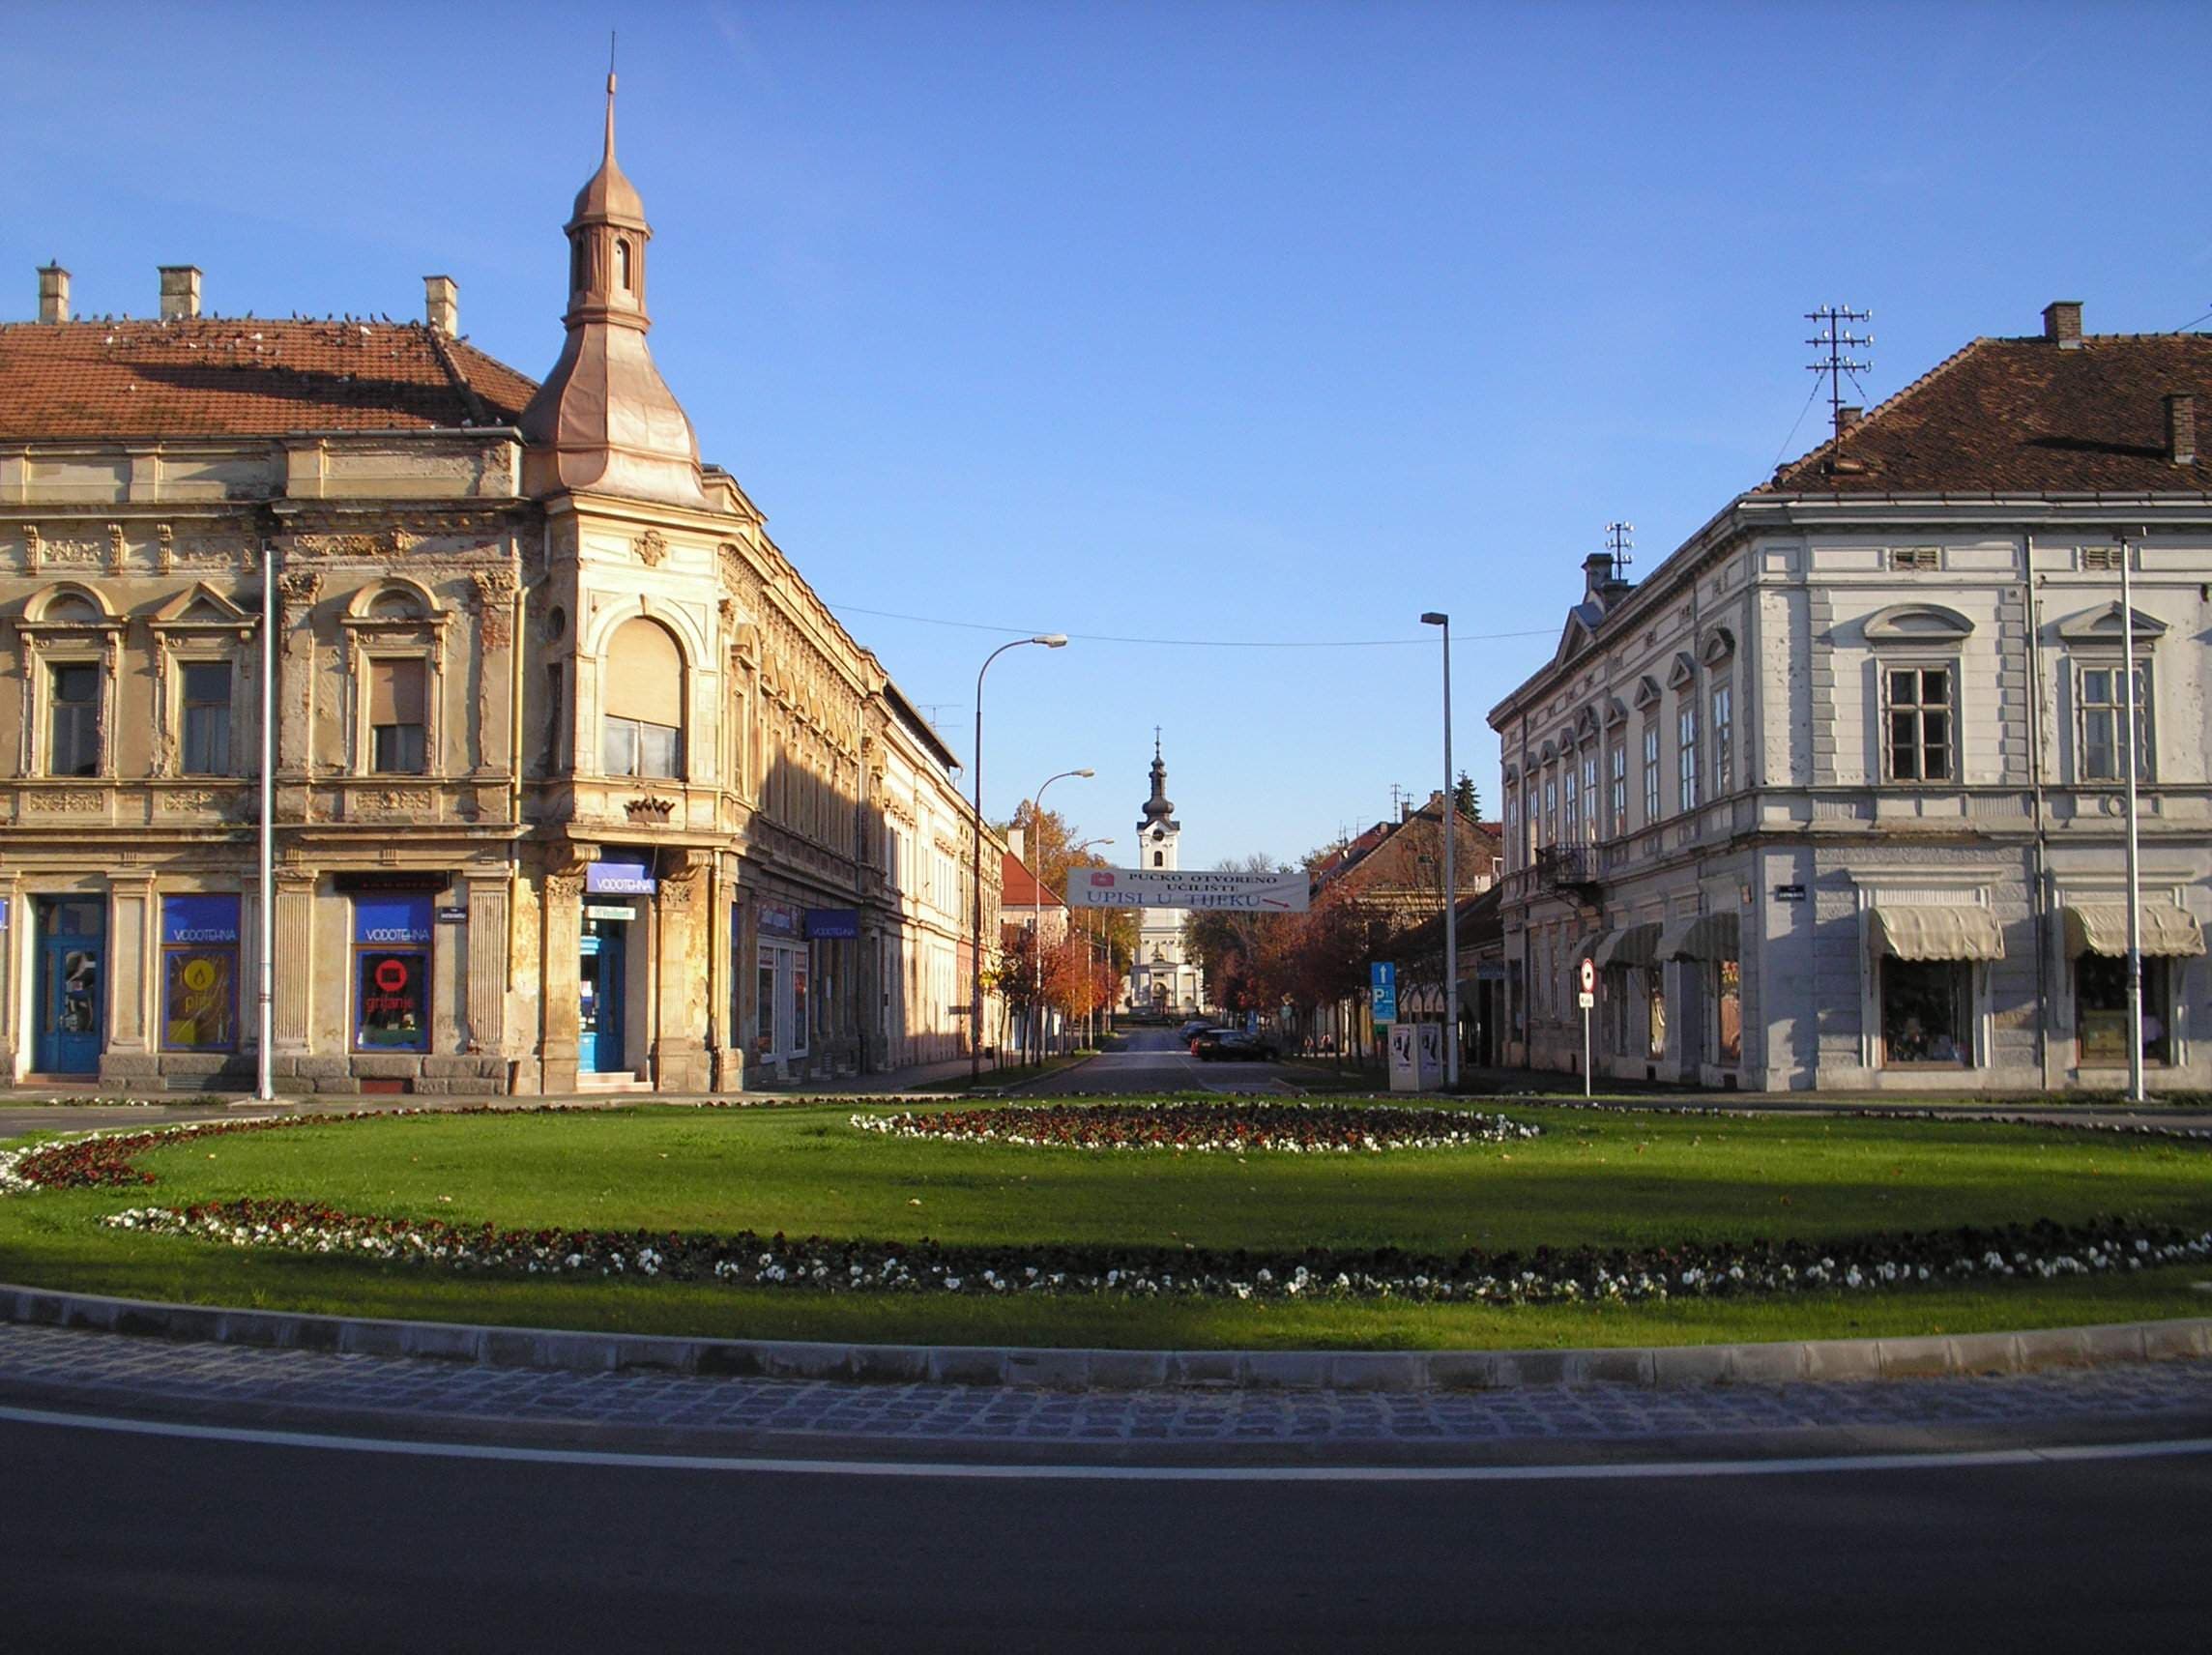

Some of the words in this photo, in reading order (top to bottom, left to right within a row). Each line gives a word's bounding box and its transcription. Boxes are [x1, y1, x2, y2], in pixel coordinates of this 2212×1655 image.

[596, 878, 652, 890] VODOTEHNA
[1190, 875, 1277, 884] OTVORENO
[1087, 890, 1144, 904] UPISI
[1157, 893, 1172, 904] U
[174, 929, 236, 941] VODOTEHNA
[365, 928, 429, 941] VODOTEHNA
[1374, 988, 1384, 1002] P
